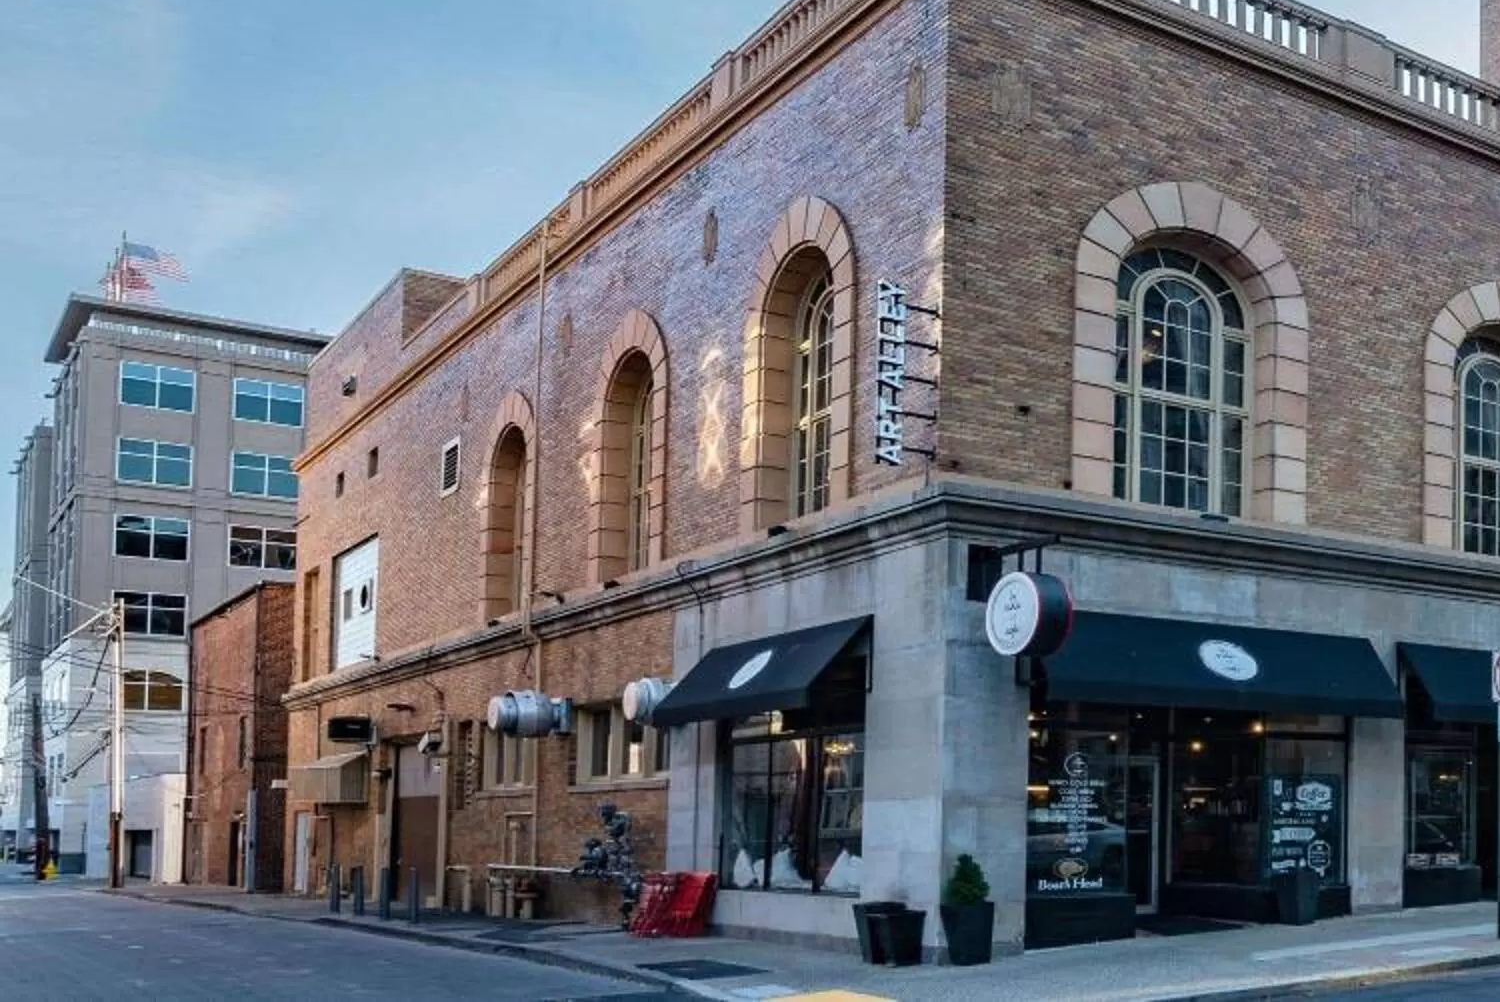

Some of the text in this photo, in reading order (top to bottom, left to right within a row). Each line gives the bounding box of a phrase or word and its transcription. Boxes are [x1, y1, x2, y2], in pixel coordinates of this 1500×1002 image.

[876, 279, 906, 465] ART ALLEY
[1073, 878, 1103, 889] Head
